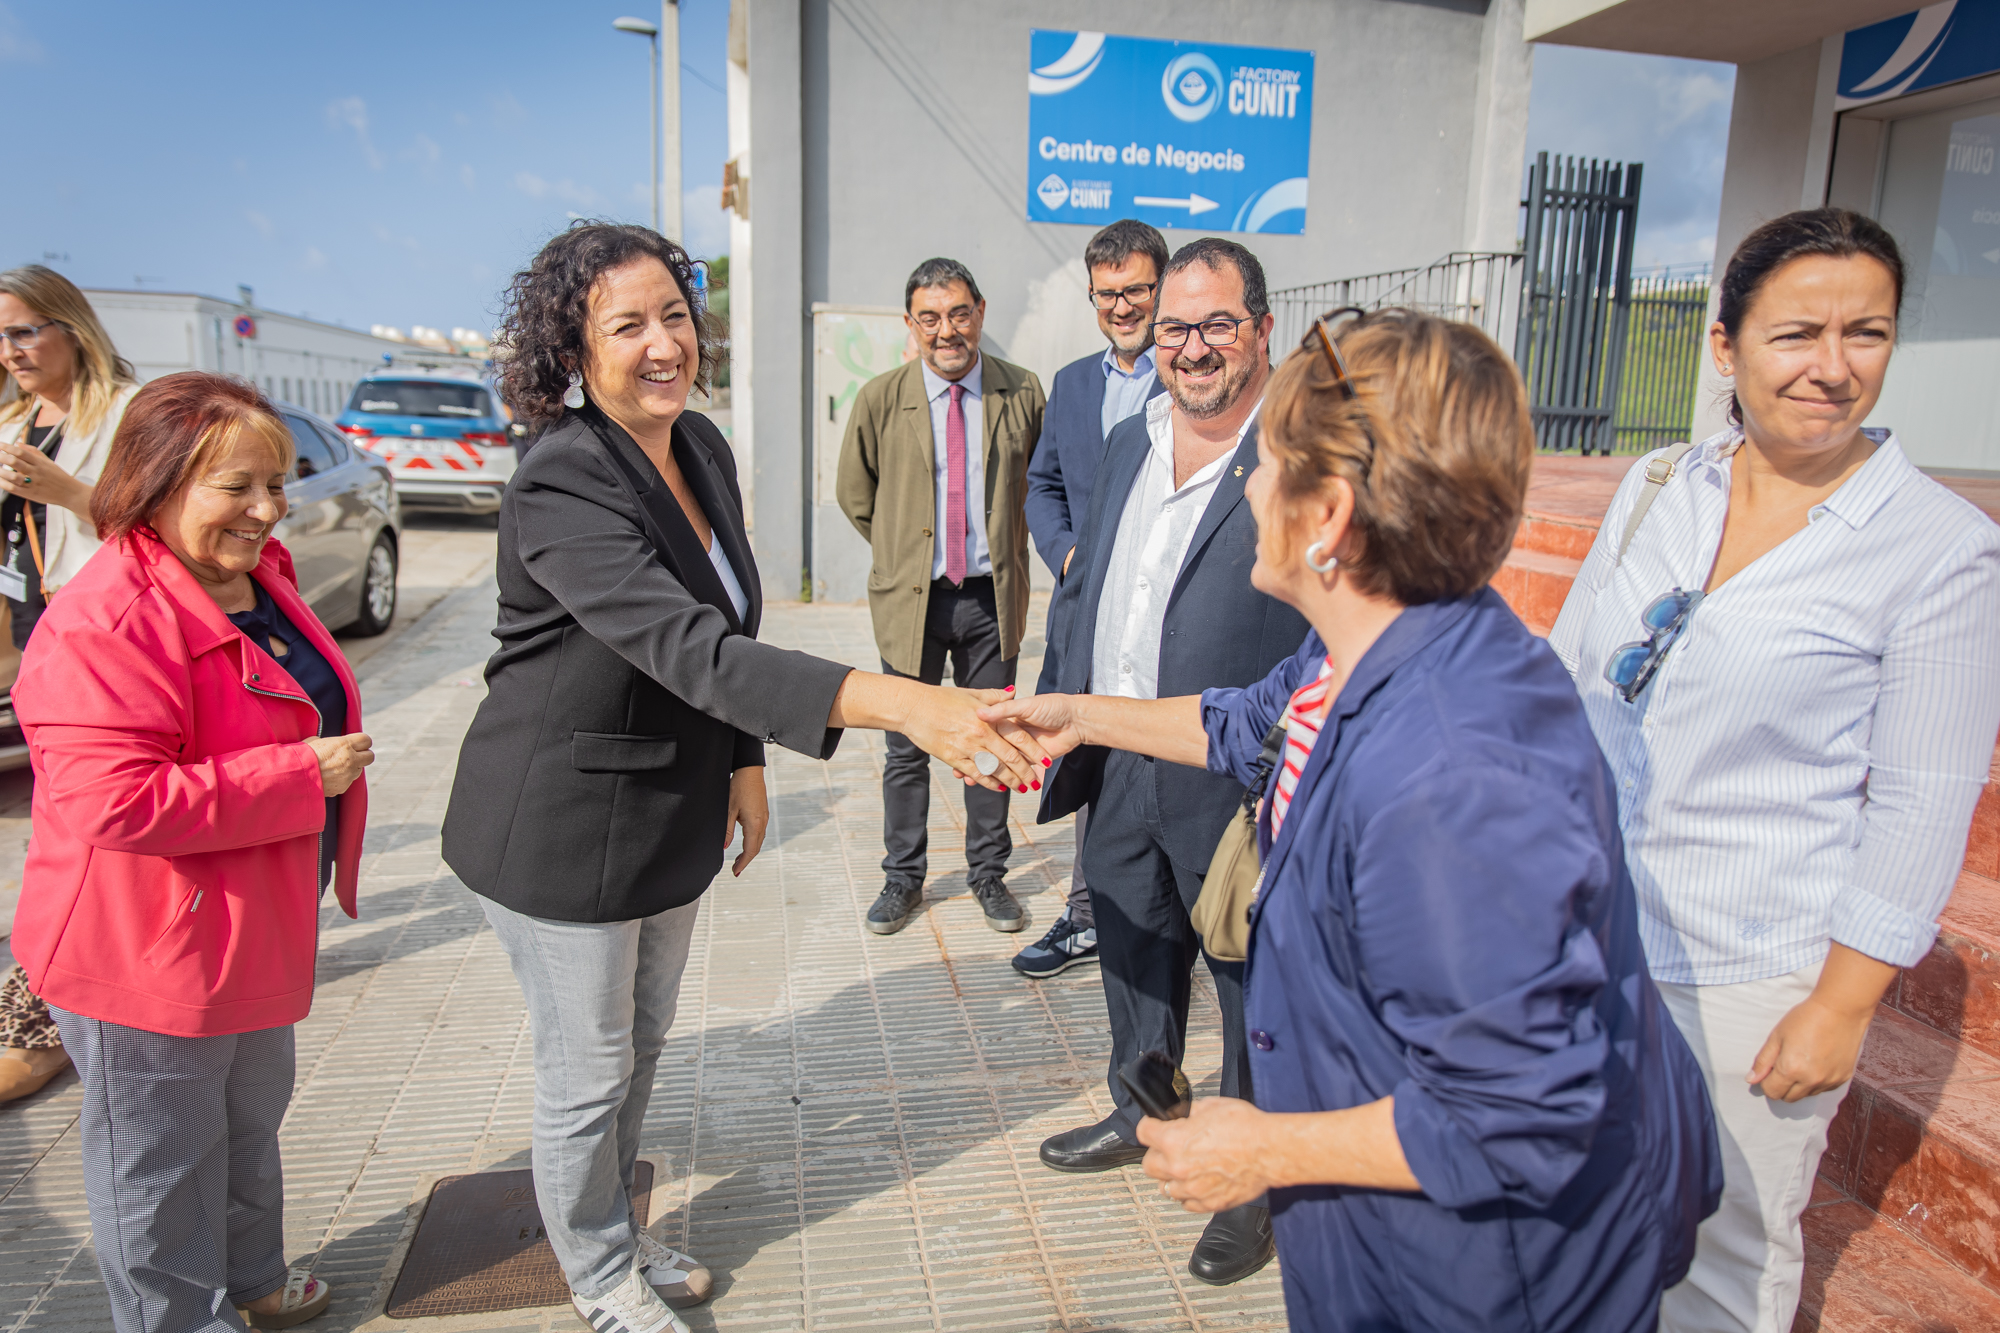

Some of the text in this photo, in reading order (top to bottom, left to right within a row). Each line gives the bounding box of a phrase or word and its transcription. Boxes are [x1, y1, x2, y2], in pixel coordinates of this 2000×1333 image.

[1228, 79, 1301, 118] CUNIT
[1038, 136, 1245, 174] Centre de Negocis
[1070, 187, 1112, 209] CUNIT
[499, 1276, 539, 1286] DUCTIL
[428, 1288, 489, 1299] IGUALADA
